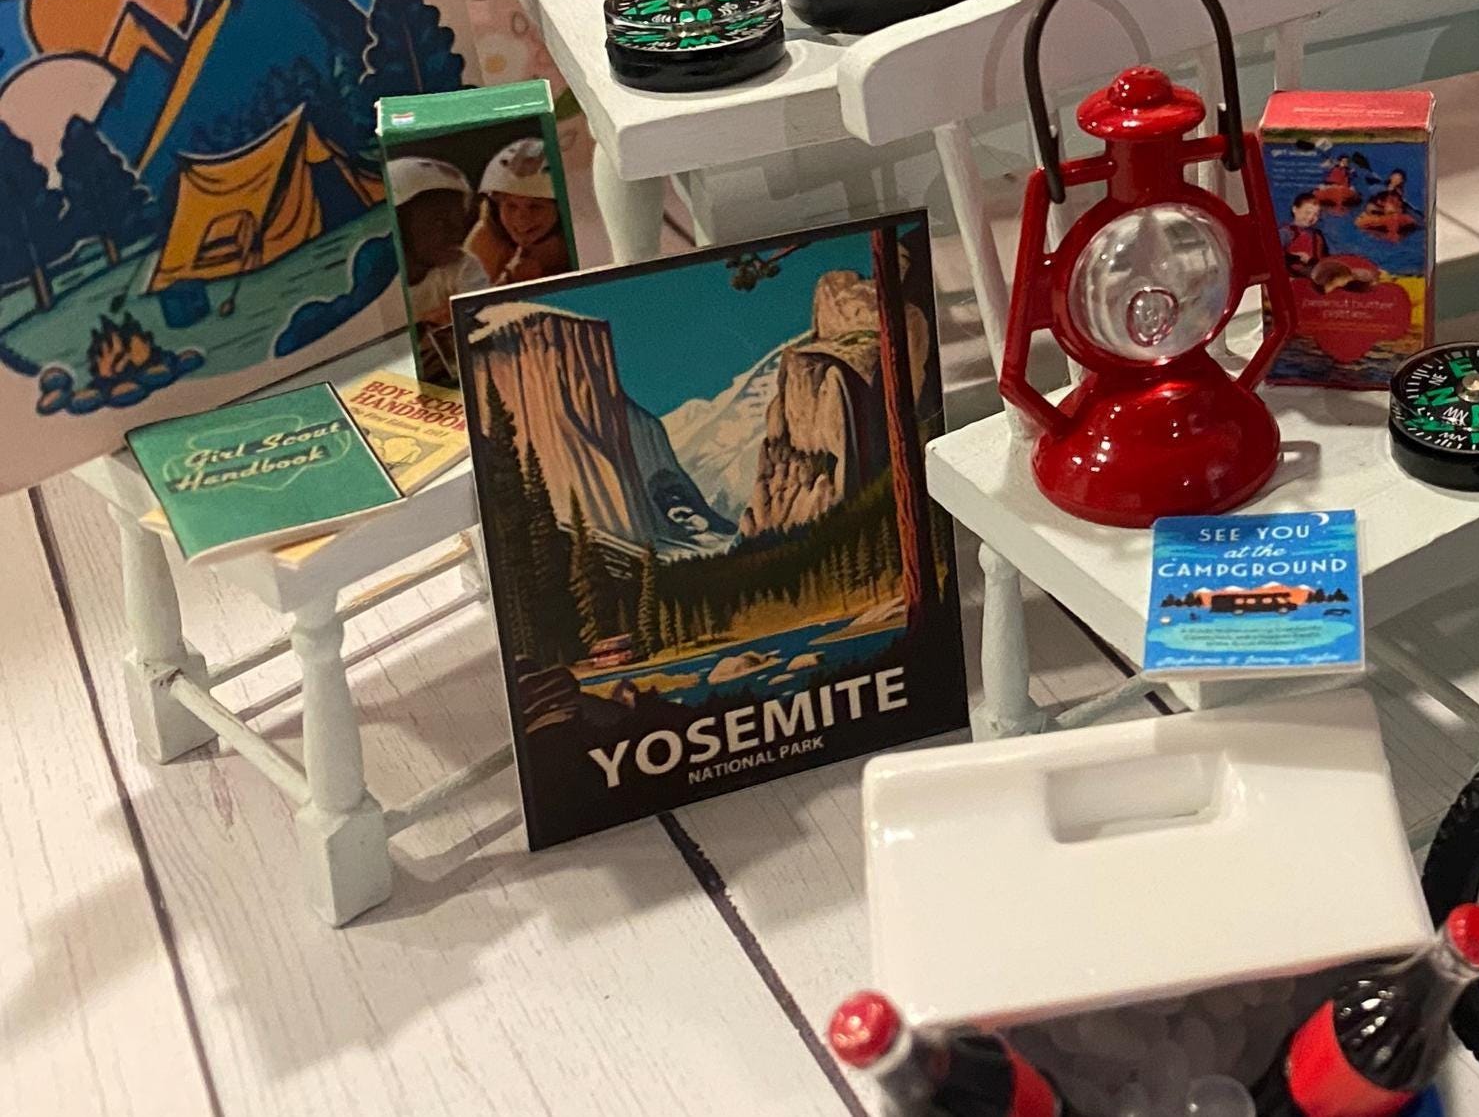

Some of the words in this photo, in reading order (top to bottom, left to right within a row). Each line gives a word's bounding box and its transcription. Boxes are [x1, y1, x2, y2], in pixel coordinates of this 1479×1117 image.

[1449, 357, 1478, 379] E
[363, 381, 413, 399] BOY
[408, 394, 464, 416] SCOU
[1427, 386, 1460, 406] N
[185, 444, 246, 470] Girl
[255, 420, 342, 454] Scout
[171, 445, 325, 491] Handbook
[1198, 527, 1241, 542] SEE
[1256, 525, 1310, 540] YOU
[1223, 545, 1250, 559] at
[1250, 543, 1287, 558] the
[1158, 558, 1348, 578] CAMPGROUND
[588, 666, 909, 790] YOSEMITE
[687, 750, 777, 785] NATIONAL
[778, 735, 825, 760] PARK
